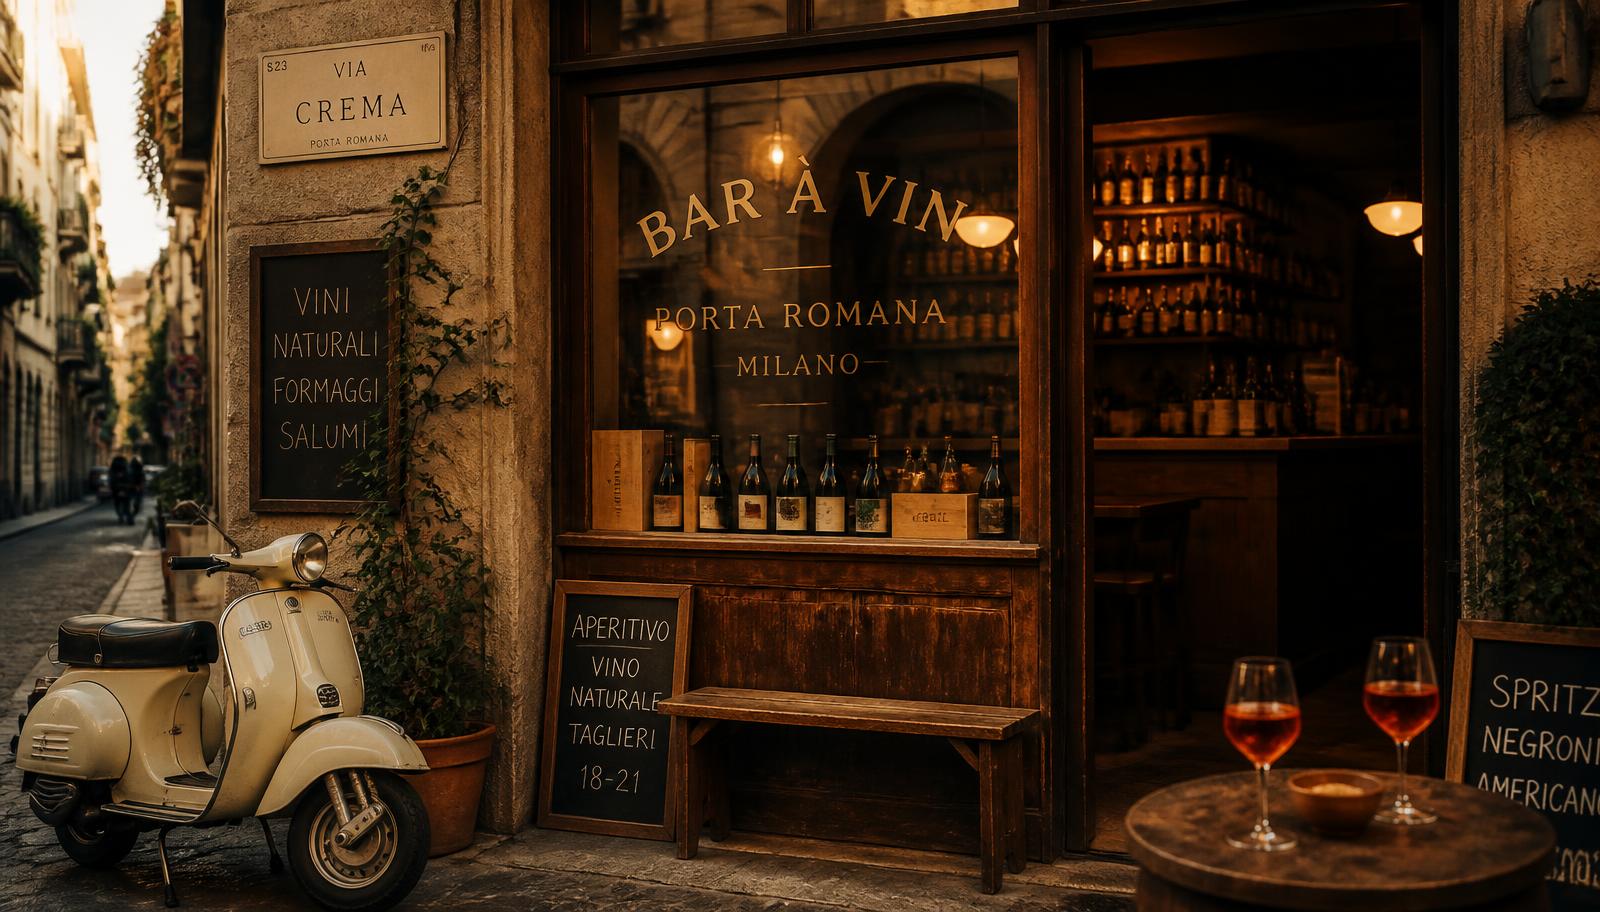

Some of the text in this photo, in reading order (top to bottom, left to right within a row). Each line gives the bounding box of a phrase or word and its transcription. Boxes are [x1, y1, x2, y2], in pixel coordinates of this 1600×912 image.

[267, 60, 287, 73] S23
[334, 60, 367, 78] VIA
[296, 93, 407, 125] CREMA
[310, 134, 389, 149] PORTA ROMANA
[636, 154, 969, 259] BAR À VIN
[294, 287, 350, 316] VINI
[654, 298, 948, 331] PORTA ROMANA
[273, 331, 378, 359] NATURALI
[736, 353, 861, 377] MILANO
[273, 376, 379, 405] FORMAGGI
[279, 420, 367, 450] SALUMI
[571, 614, 670, 642] APERITIVO
[591, 655, 640, 678] VINO
[570, 686, 663, 712] NATURALE
[1489, 674, 1600, 718] SPRITZ
[568, 723, 656, 750] TAGLIERI
[1481, 725, 1600, 766] NEGRONI
[580, 764, 641, 795] 18-21
[1478, 772, 1600, 816] AMERICAN
